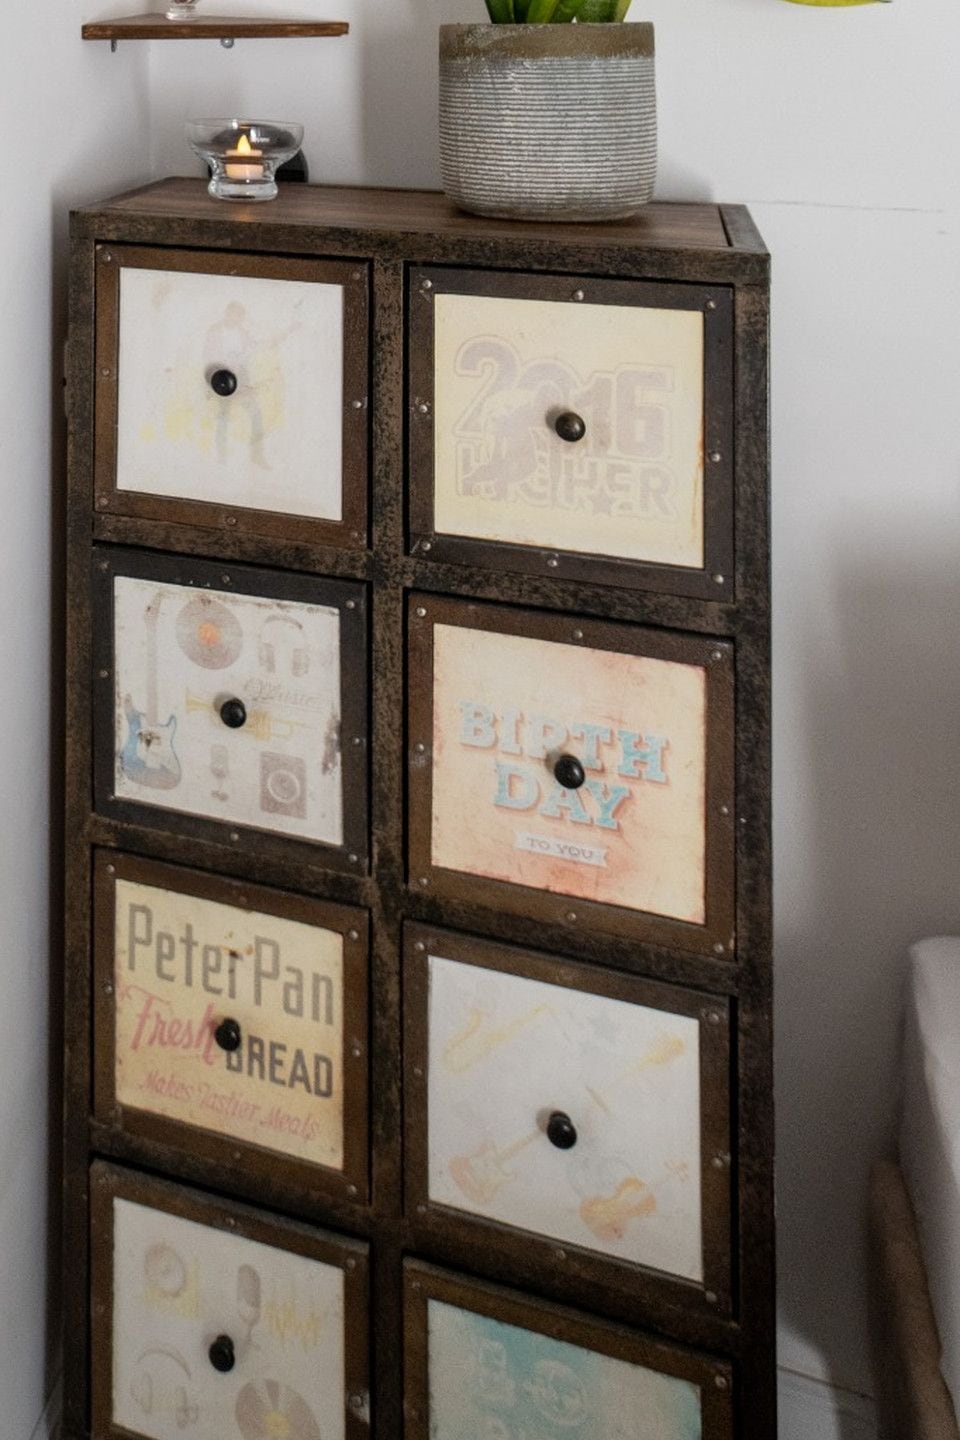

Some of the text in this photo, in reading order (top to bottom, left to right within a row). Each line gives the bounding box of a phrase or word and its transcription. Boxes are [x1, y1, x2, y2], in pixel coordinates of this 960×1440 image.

[453, 335, 674, 459] 2016
[455, 440, 678, 522] HGHER
[459, 701, 669, 784] BIRTH
[494, 761, 633, 833] DAY
[526, 836, 593, 860] TO YOU
[128, 902, 334, 1026] Peter Pan
[123, 983, 216, 1066] Fresh
